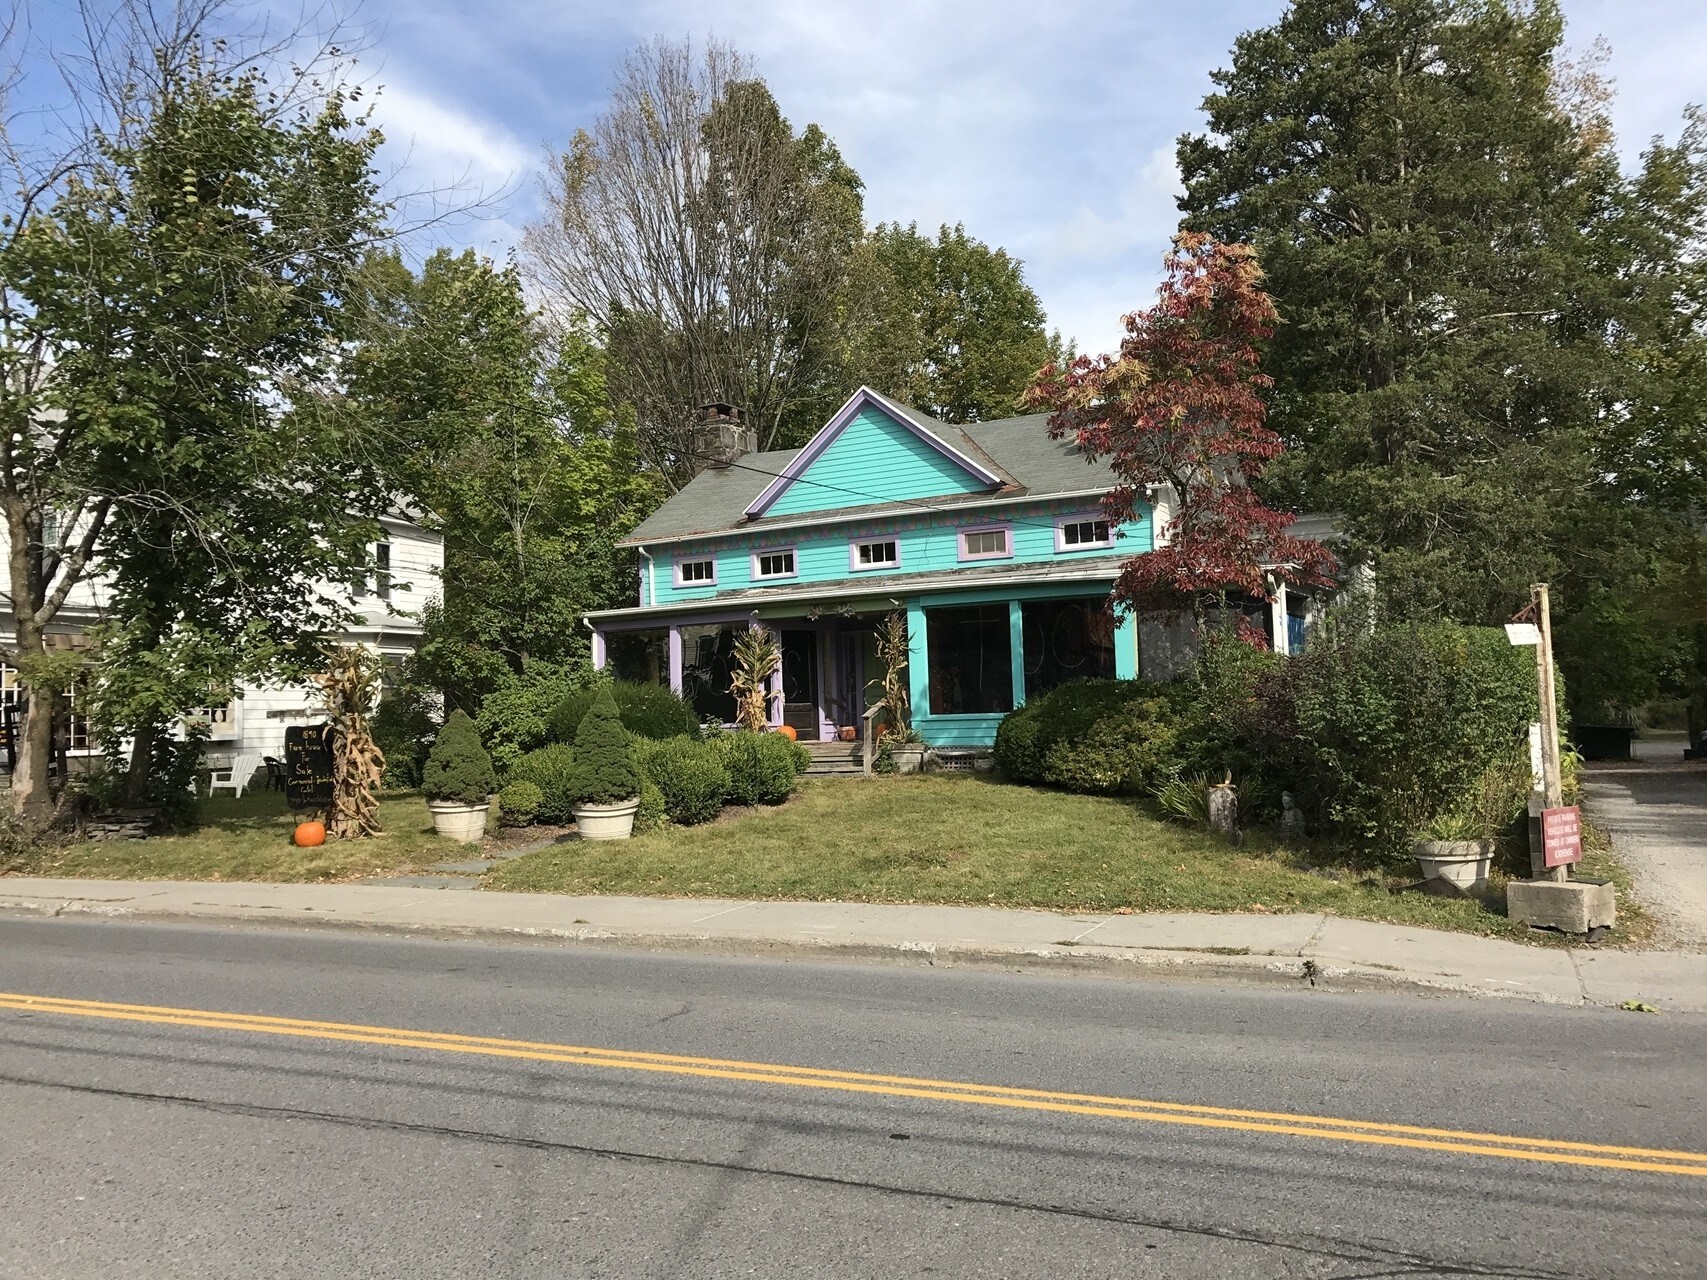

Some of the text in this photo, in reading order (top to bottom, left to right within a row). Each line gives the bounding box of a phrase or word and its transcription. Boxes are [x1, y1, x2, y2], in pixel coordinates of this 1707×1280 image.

[296, 764, 312, 776] Sale
[1547, 826, 1564, 836] VEHICLES
[1564, 824, 1572, 832] WILL
[1546, 838, 1560, 848] TOWED
[1554, 848, 1574, 858] EXPENSE
